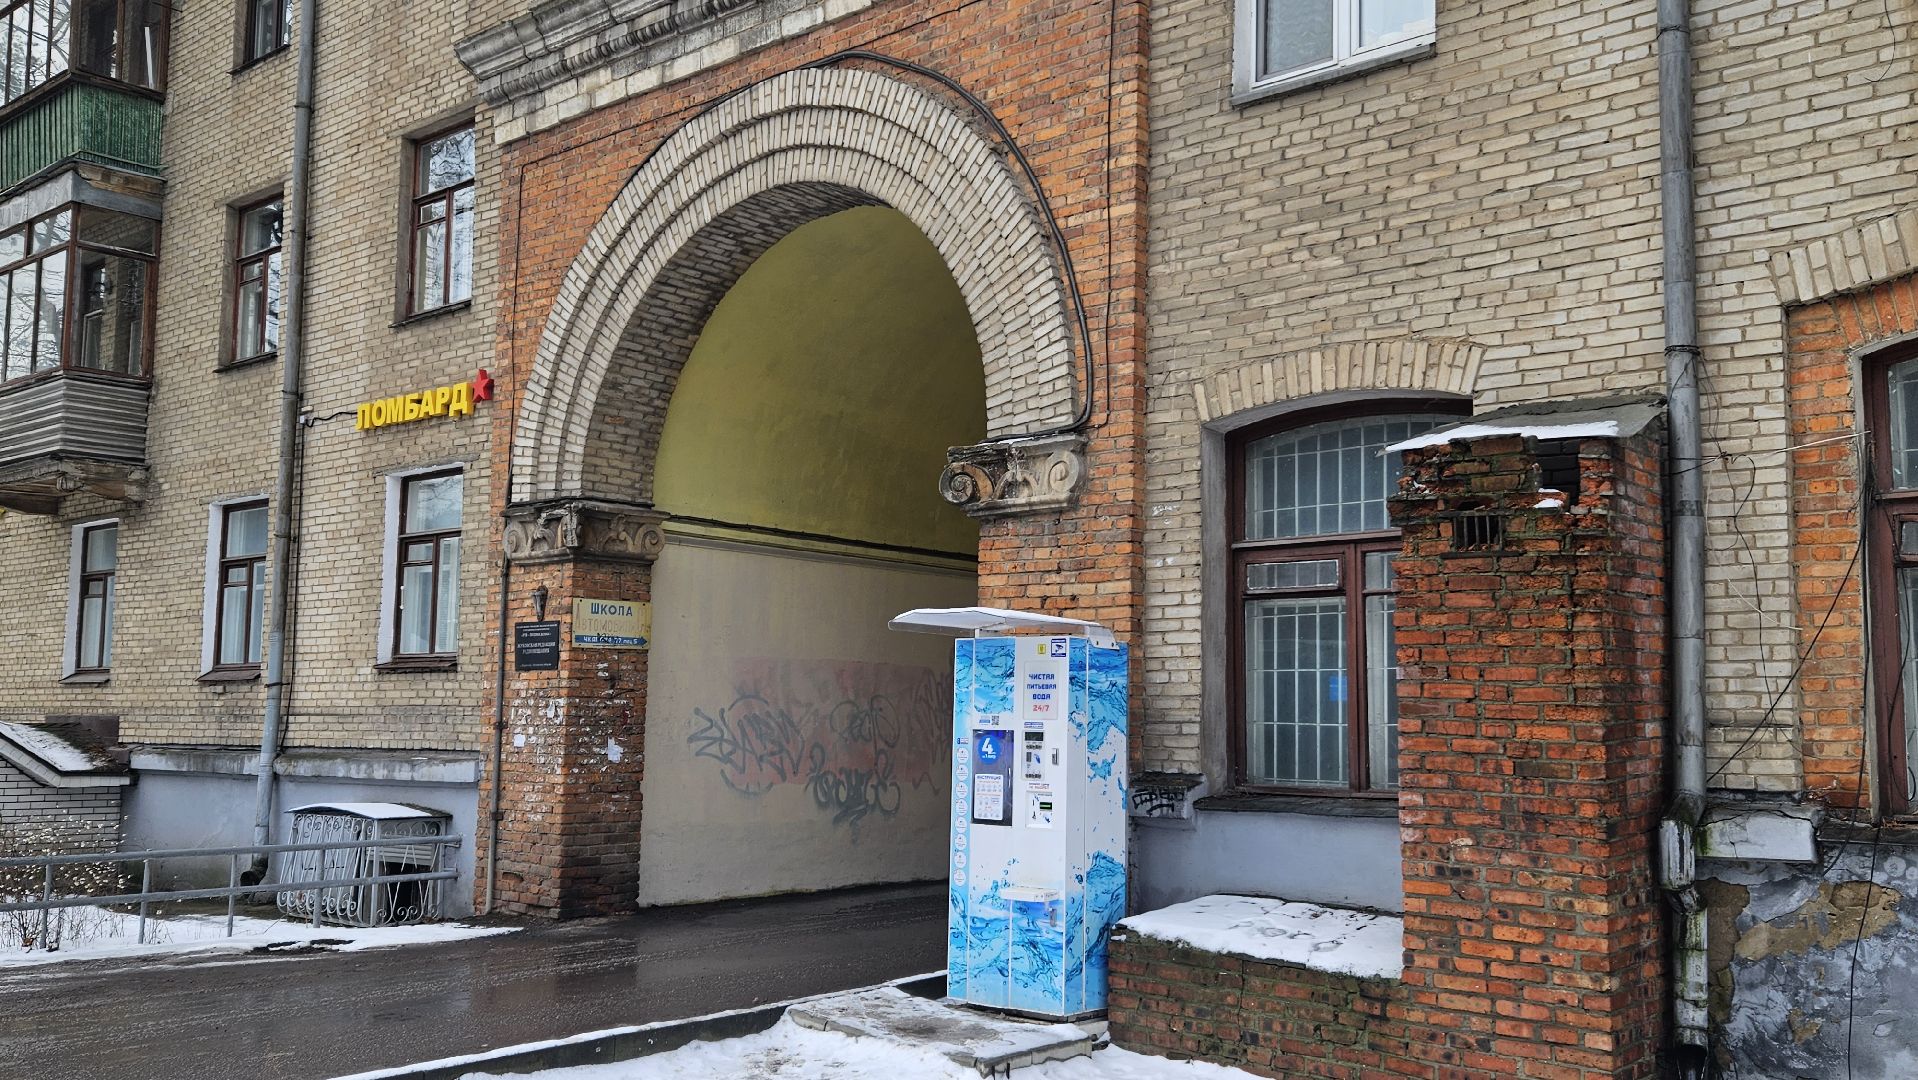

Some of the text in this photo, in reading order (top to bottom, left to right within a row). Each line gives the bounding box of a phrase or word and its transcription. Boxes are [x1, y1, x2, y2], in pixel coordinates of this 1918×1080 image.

[356, 381, 473, 430] ЛОМБАРД
[591, 602, 633, 617] ШКОЛА
[1032, 704, 1050, 712] 24/7
[981, 737, 994, 755] 4
